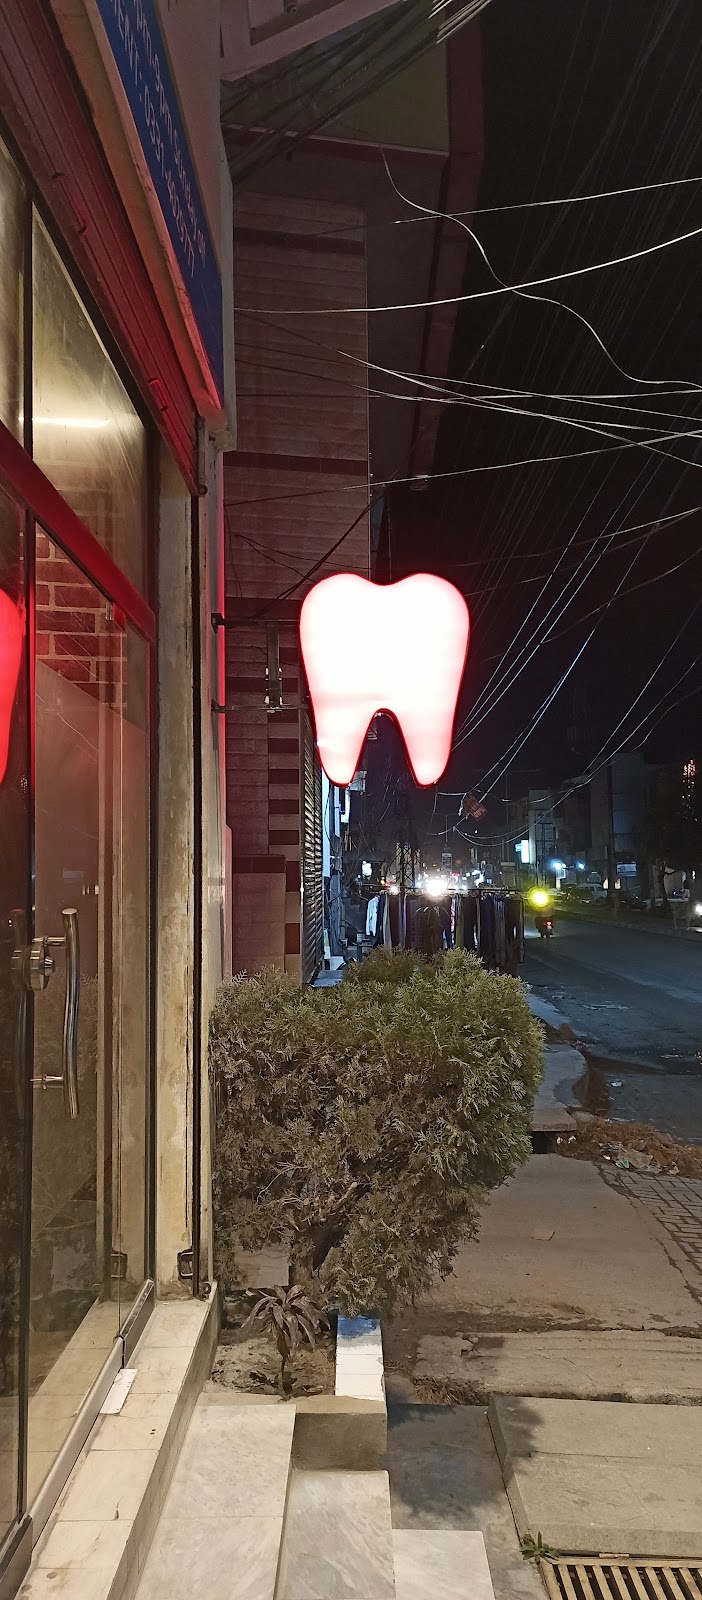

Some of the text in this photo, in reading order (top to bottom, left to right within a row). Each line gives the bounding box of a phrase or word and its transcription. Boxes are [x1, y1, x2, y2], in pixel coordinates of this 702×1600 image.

[110, 0, 142, 102] ENT:
[133, 0, 173, 144] pm-9pm
[173, 129, 198, 240] Sunday
